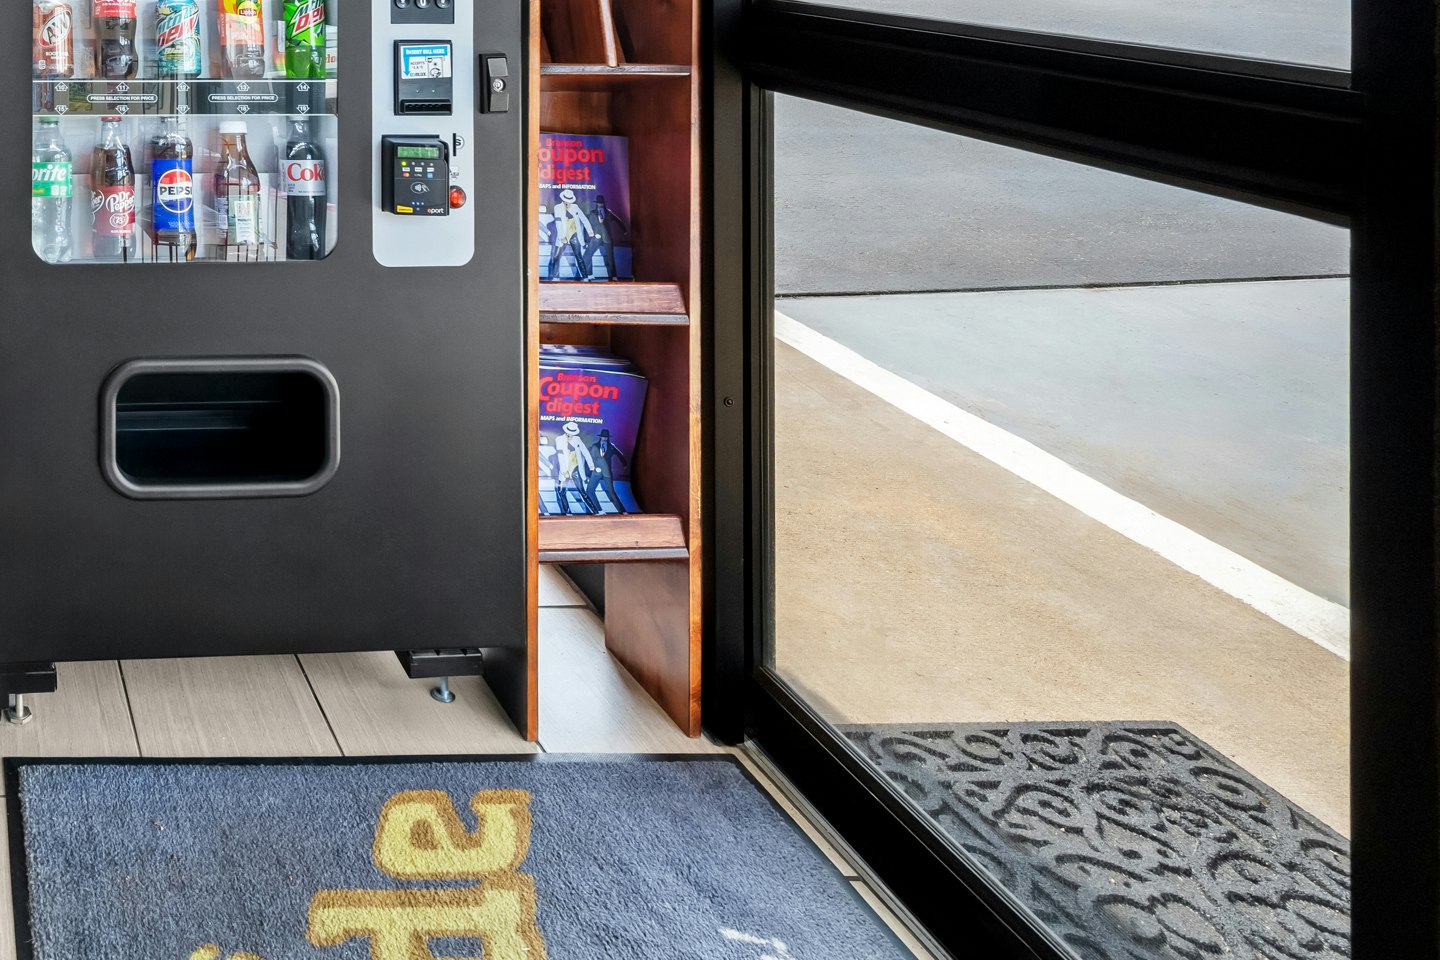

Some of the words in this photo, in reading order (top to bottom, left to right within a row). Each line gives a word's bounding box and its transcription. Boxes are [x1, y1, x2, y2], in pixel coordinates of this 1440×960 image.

[539, 148, 605, 168] oupon
[540, 163, 591, 184] digest
[119, 191, 130, 200] Dr
[113, 216, 123, 224] 23
[557, 372, 597, 384] Branson
[539, 376, 619, 401] Coupon
[545, 398, 601, 417] digest
[566, 416, 603, 424] INFORMATION
